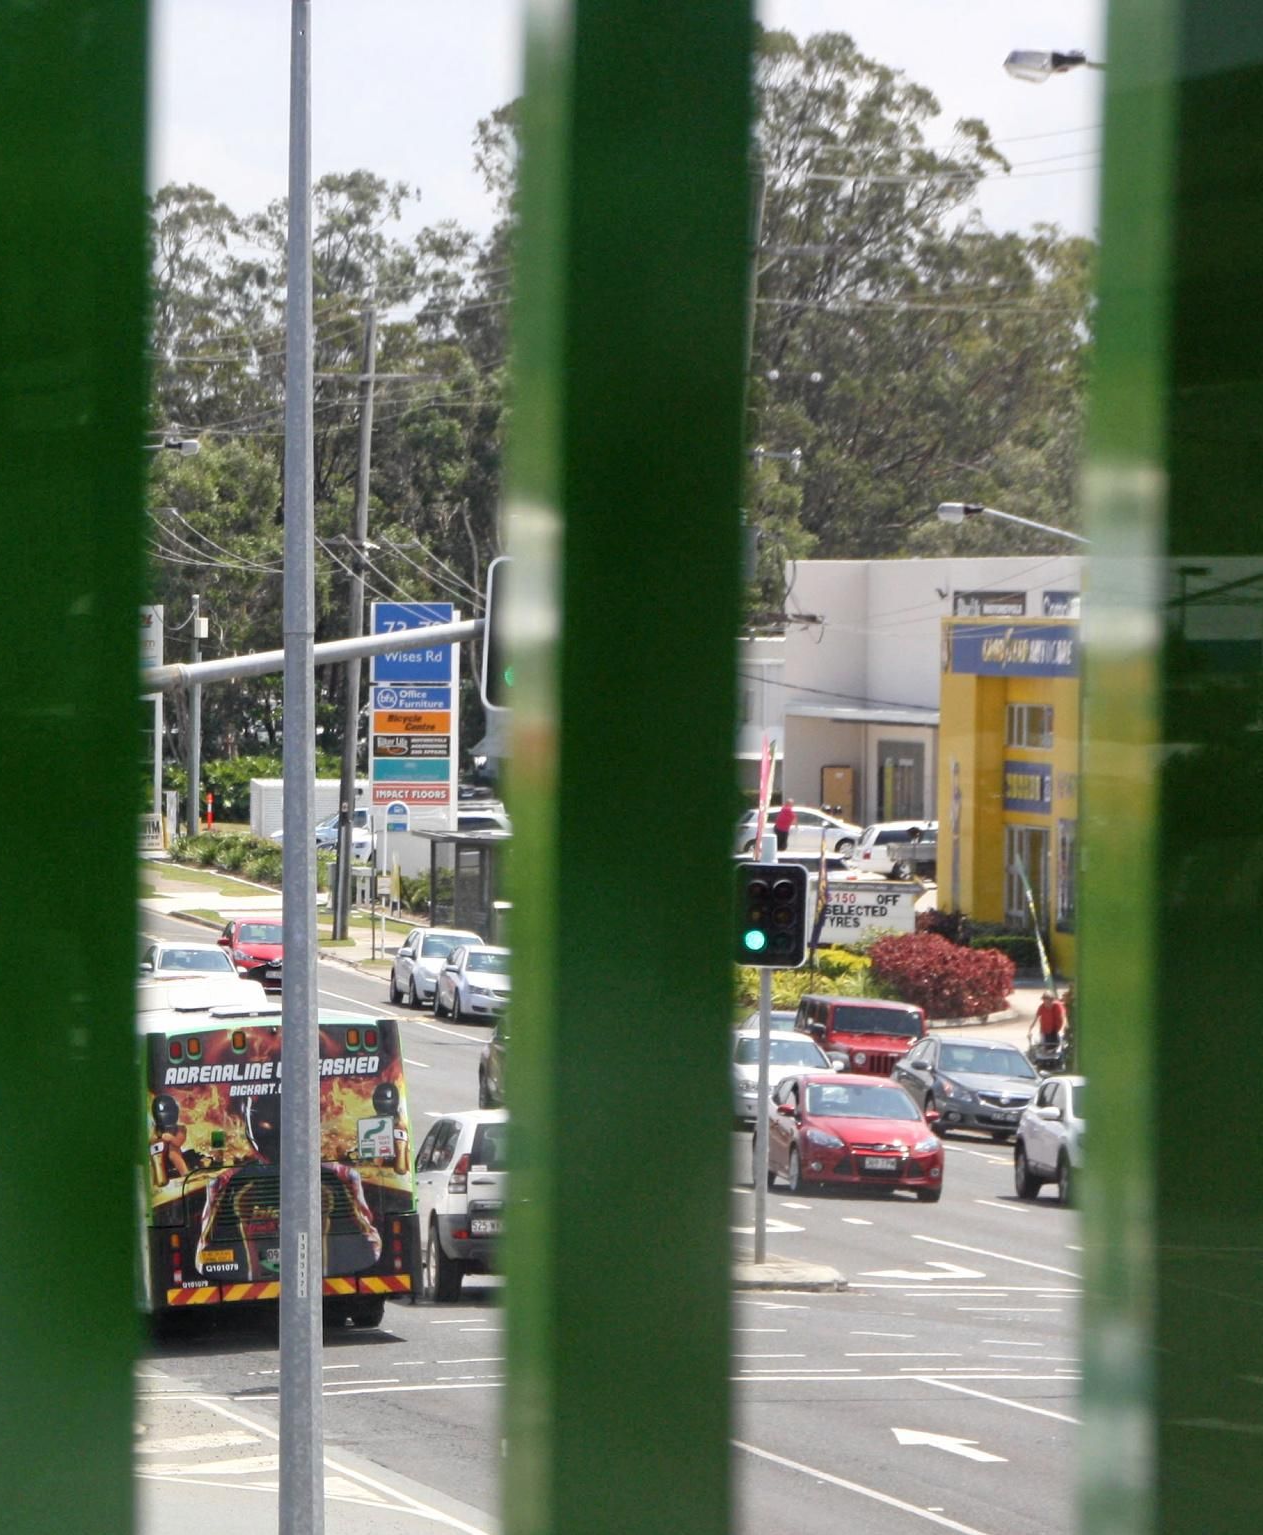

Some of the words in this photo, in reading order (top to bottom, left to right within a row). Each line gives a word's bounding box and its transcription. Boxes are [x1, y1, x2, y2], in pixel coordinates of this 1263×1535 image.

[385, 651, 422, 663] Wises
[426, 650, 442, 663] Rd
[399, 690, 427, 699] Office
[399, 699, 444, 708] Furniture
[376, 790, 409, 799] IMPACT
[412, 790, 446, 799] FLOORS
[876, 895, 900, 905] OFF
[826, 905, 888, 916] SELECTED
[827, 917, 860, 928] YRES
[165, 1061, 274, 1085] ADRENALINE
[206, 1263, 239, 1272] Q101079
